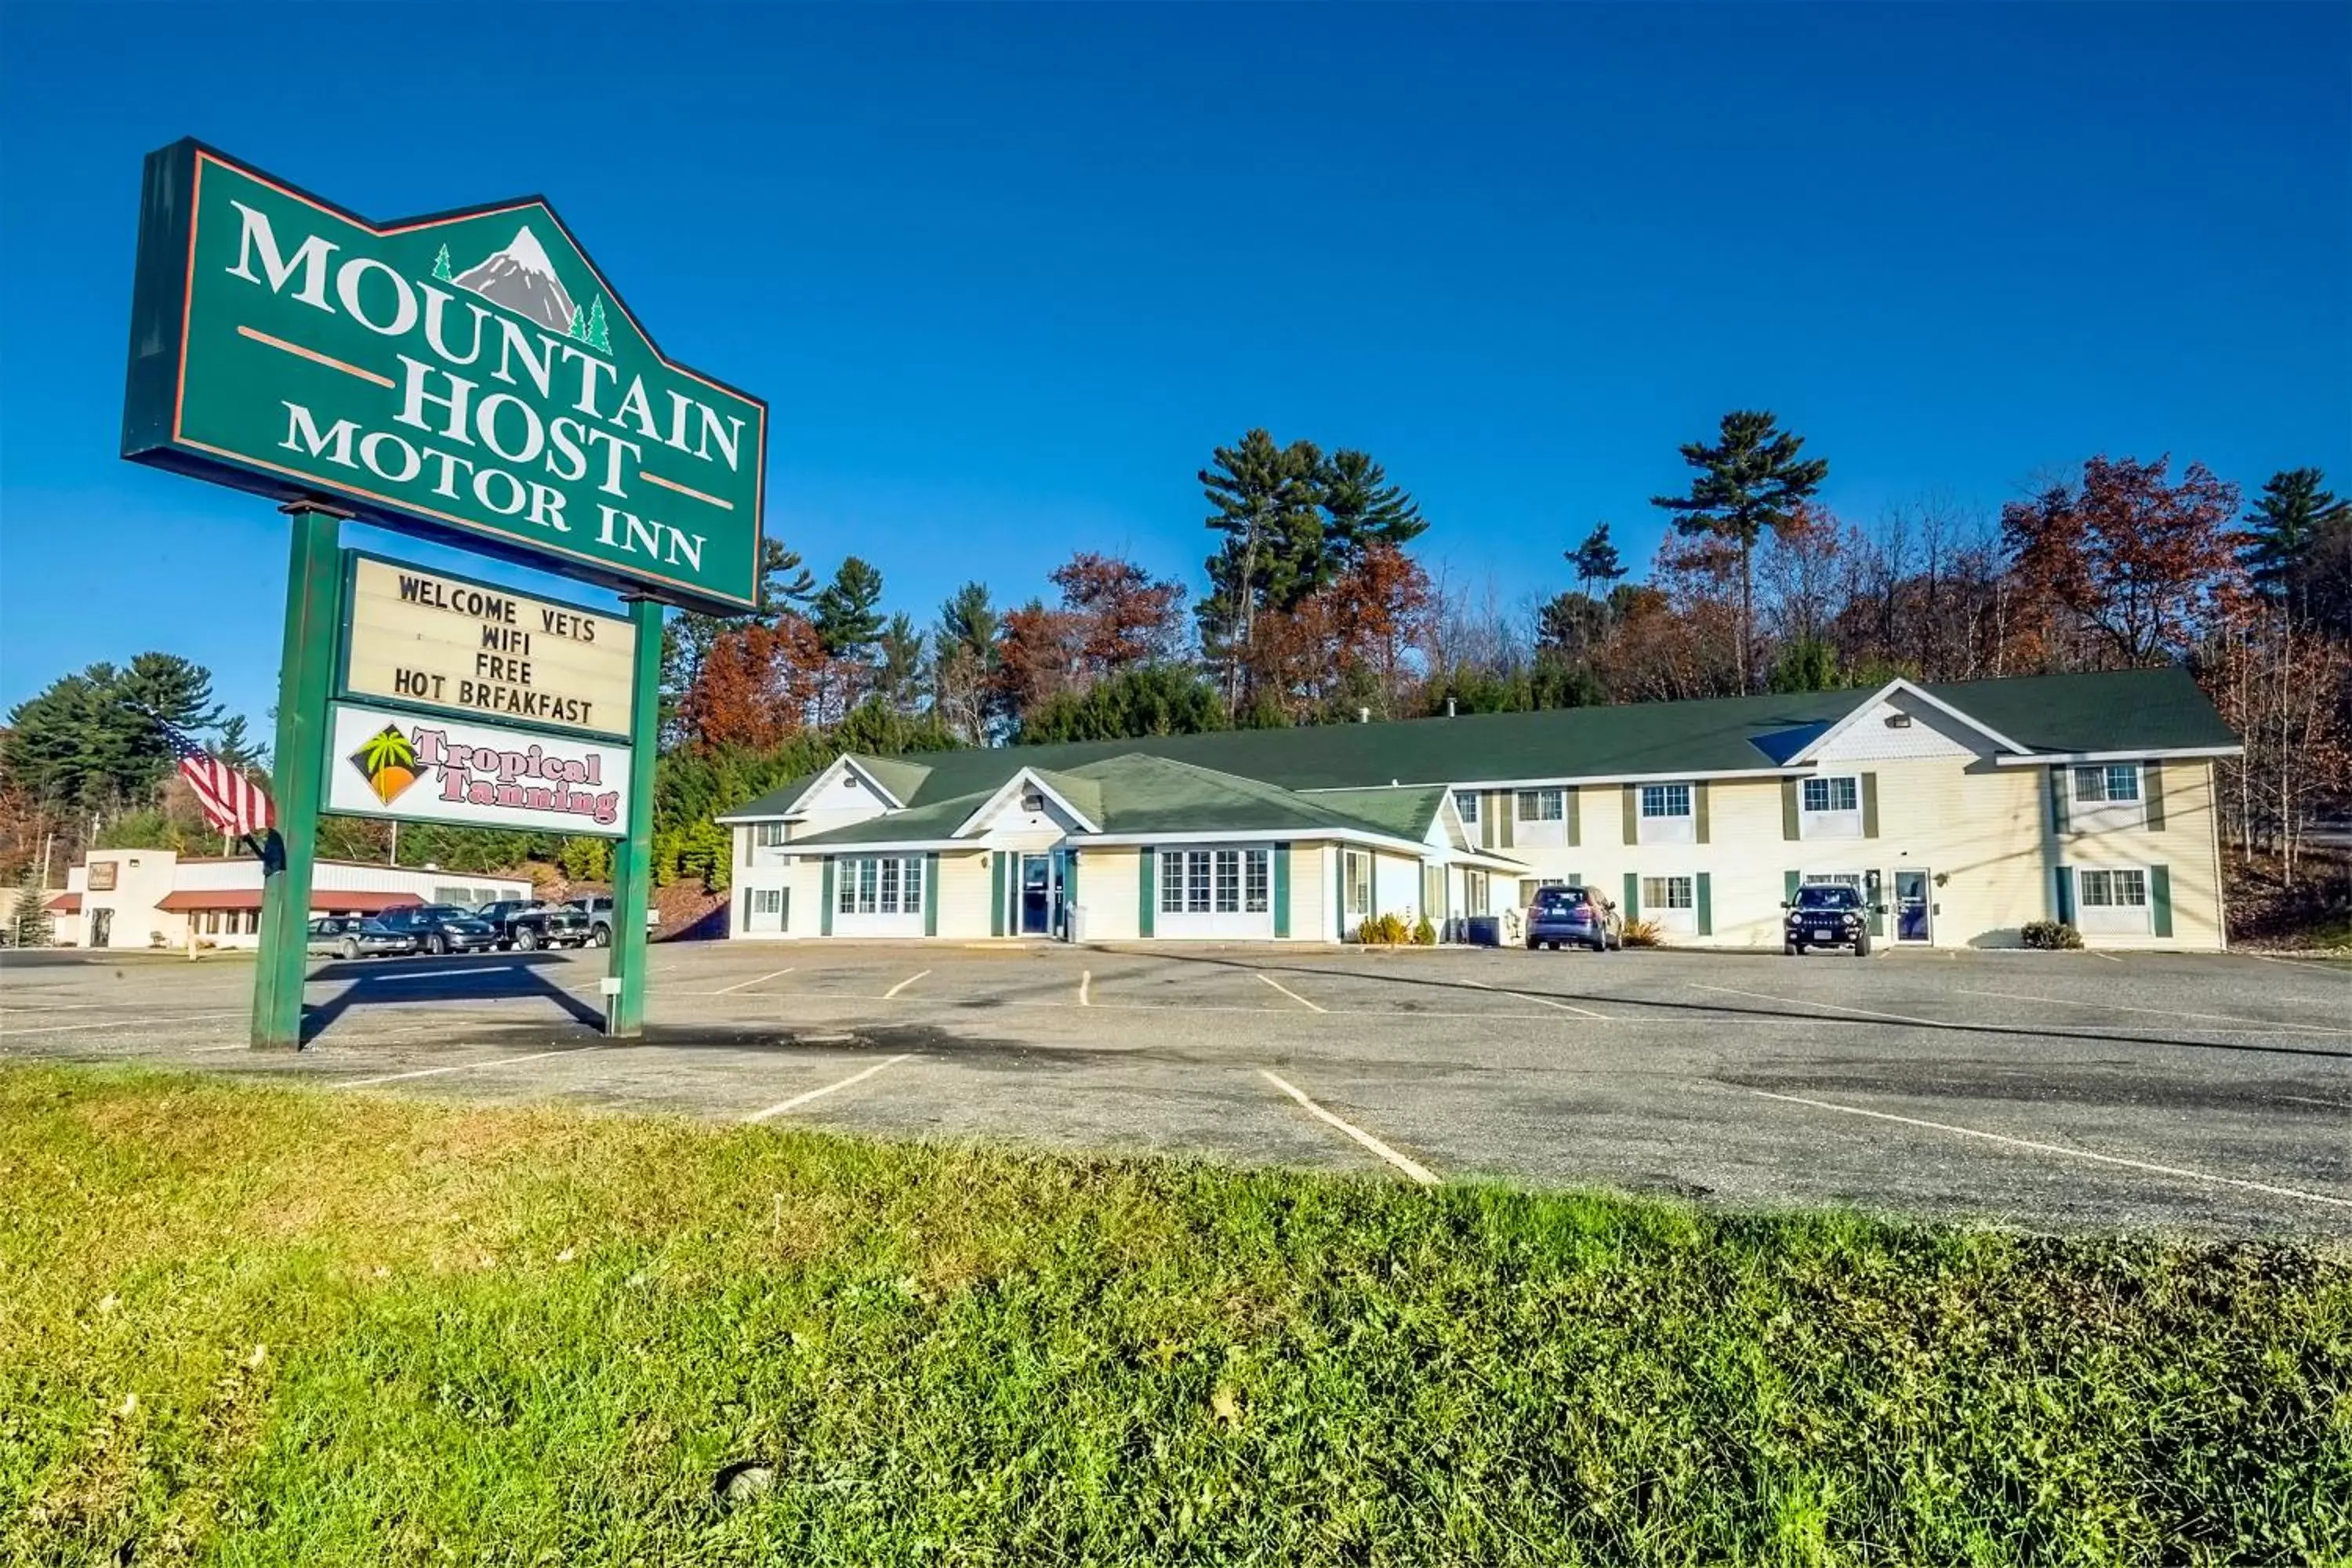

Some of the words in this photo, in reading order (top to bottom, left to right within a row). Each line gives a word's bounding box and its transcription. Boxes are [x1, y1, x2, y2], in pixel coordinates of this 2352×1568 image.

[226, 200, 746, 472] MOUNTAIN
[393, 354, 641, 498] HOST
[278, 401, 572, 532] MOTOR
[597, 504, 706, 572] INN
[399, 575, 517, 624] WELCOME
[542, 609, 596, 642] VETS
[476, 653, 532, 684] FREE
[481, 625, 530, 655] WIFI
[394, 668, 445, 699] HOT
[412, 726, 602, 786] Tropical
[437, 764, 619, 825] Tanning
